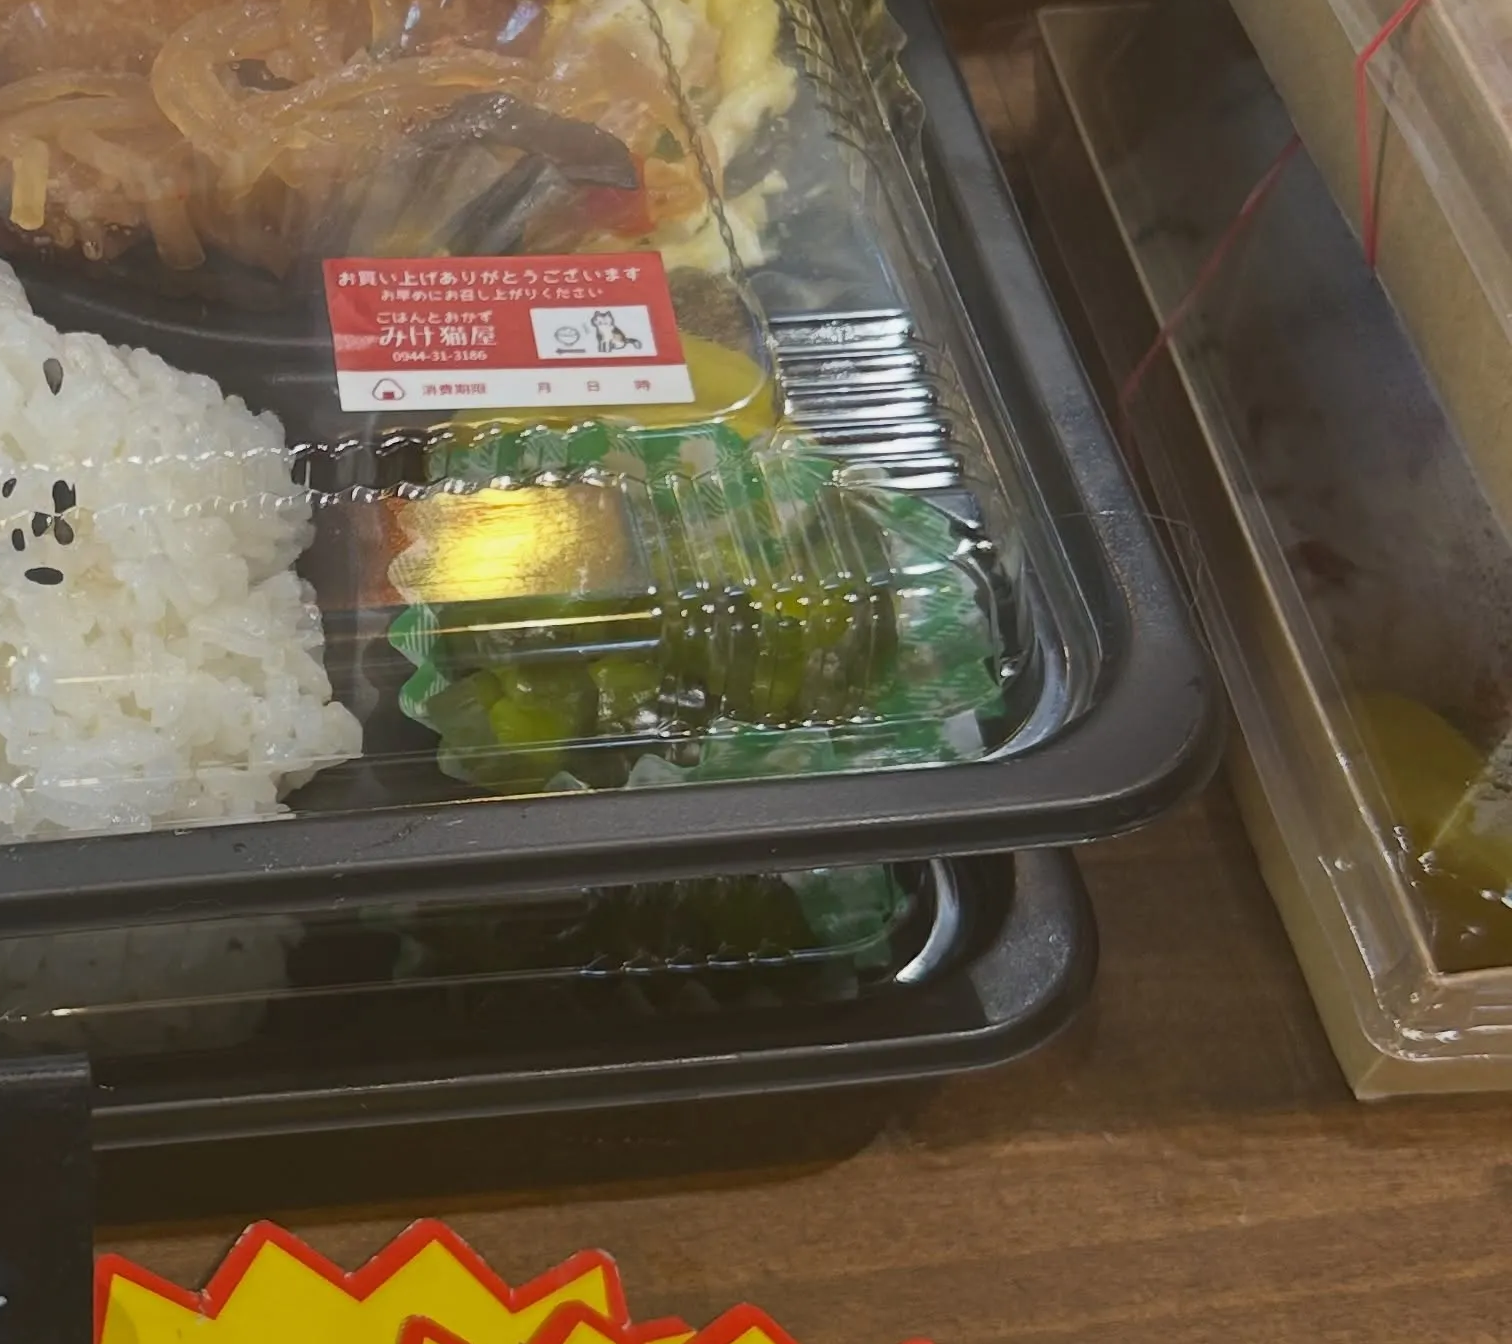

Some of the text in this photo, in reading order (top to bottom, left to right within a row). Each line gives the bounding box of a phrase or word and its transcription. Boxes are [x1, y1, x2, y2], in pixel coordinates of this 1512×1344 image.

[338, 267, 641, 287] お買い上げありがとうございます
[381, 287, 604, 303] お早めにお召し上がりください
[376, 309, 493, 325] ごはんとおかず
[378, 325, 497, 348] みけ猫屋
[422, 379, 651, 397] 消費期限 月 日 時
